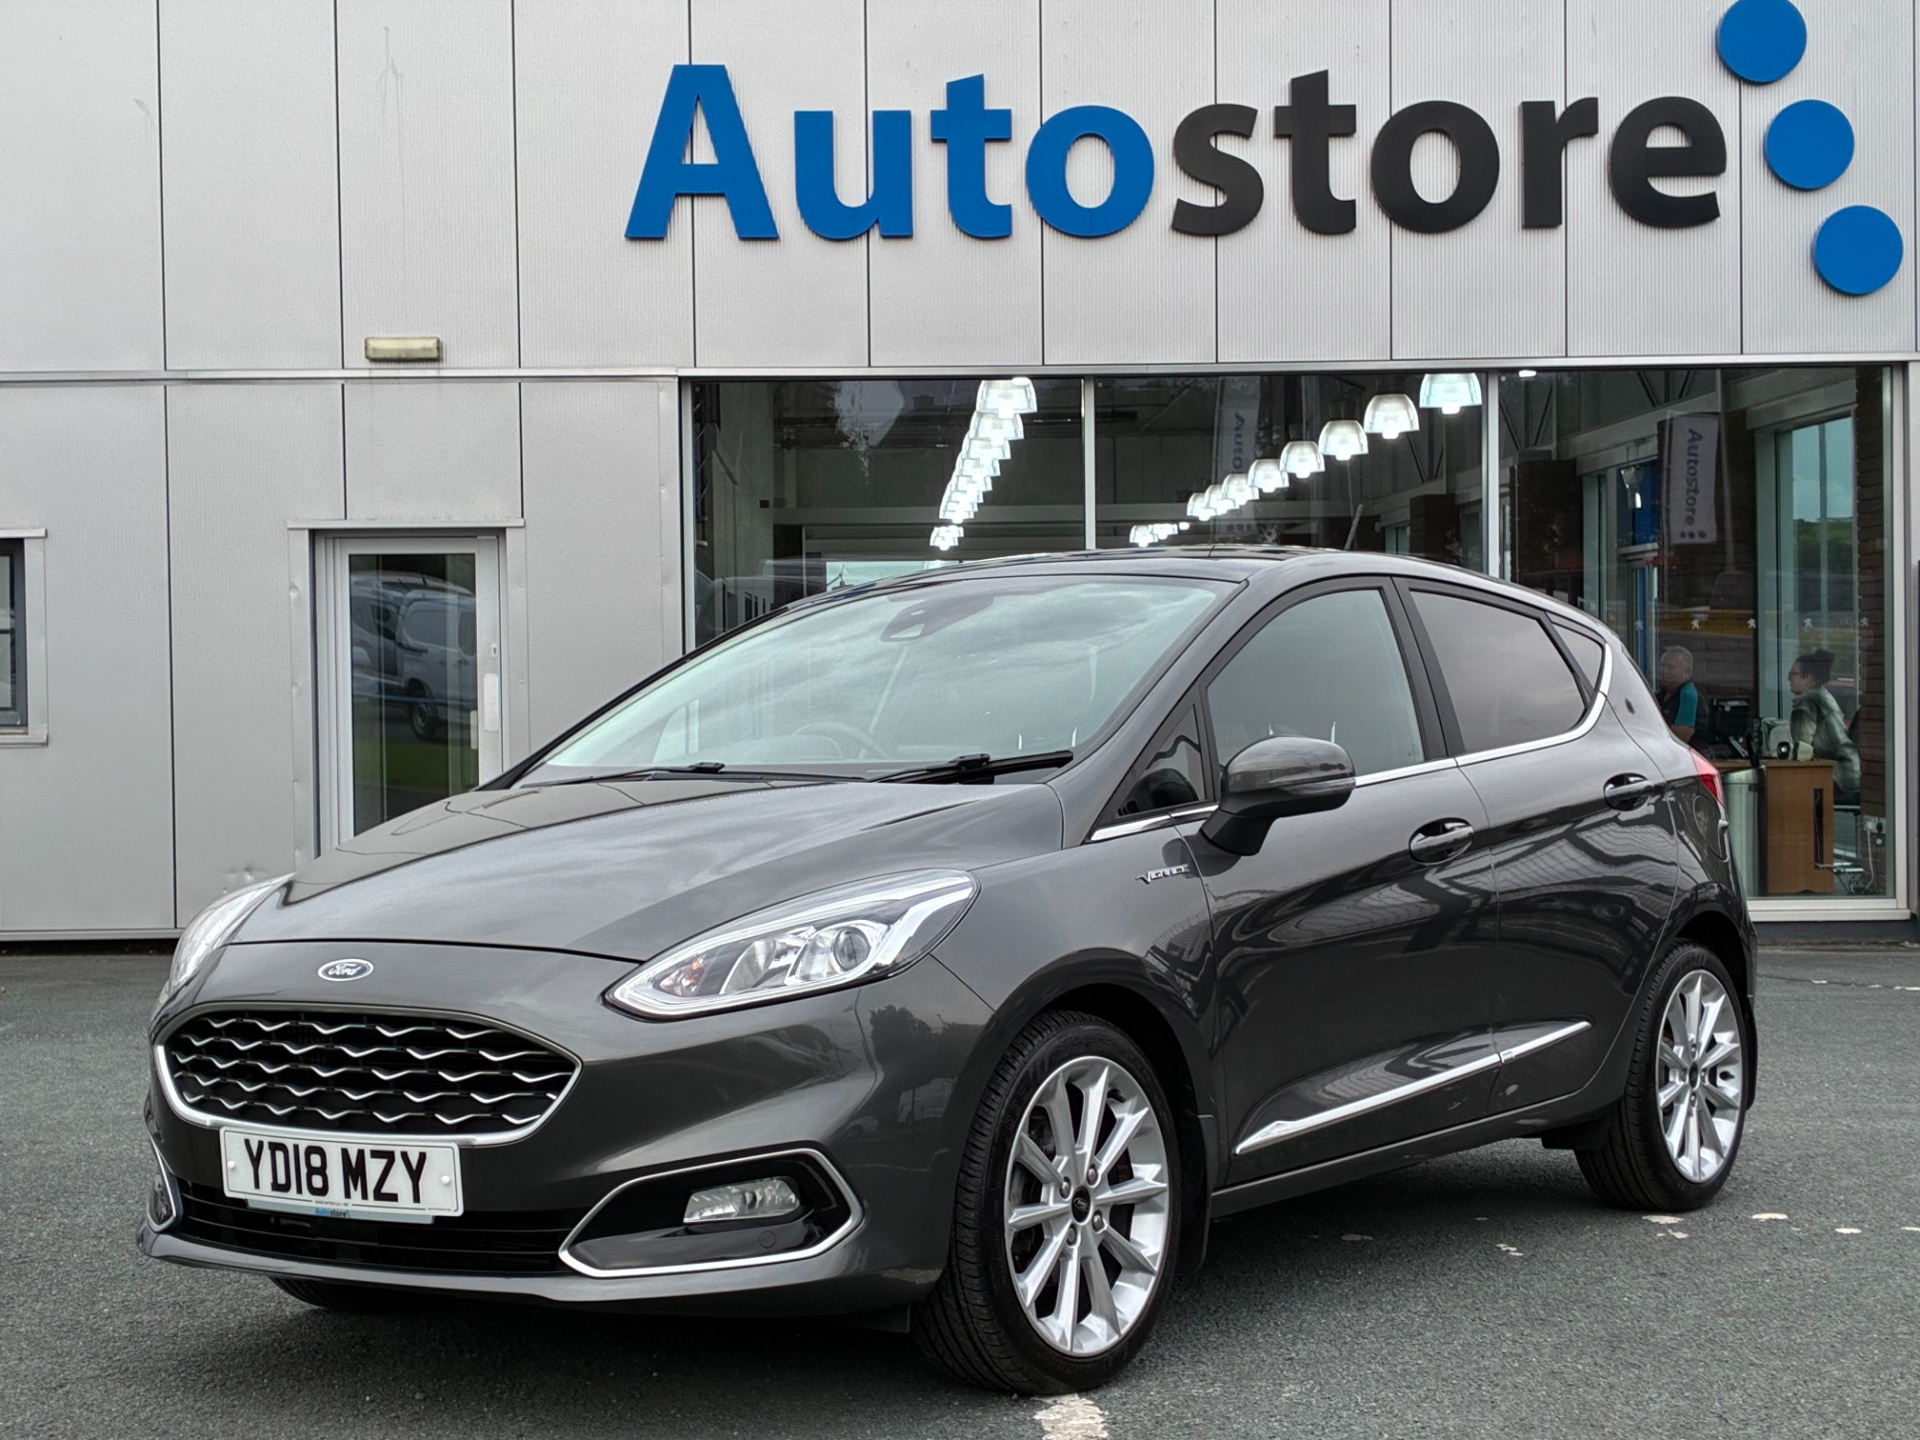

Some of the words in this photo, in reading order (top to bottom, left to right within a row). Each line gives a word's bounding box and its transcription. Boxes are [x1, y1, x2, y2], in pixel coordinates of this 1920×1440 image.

[625, 64, 1727, 239] Autostore
[1684, 428, 1704, 526] Autostore
[328, 962, 362, 976] Ford
[244, 1138, 329, 1197] YD18
[341, 1147, 427, 1204] MZY
